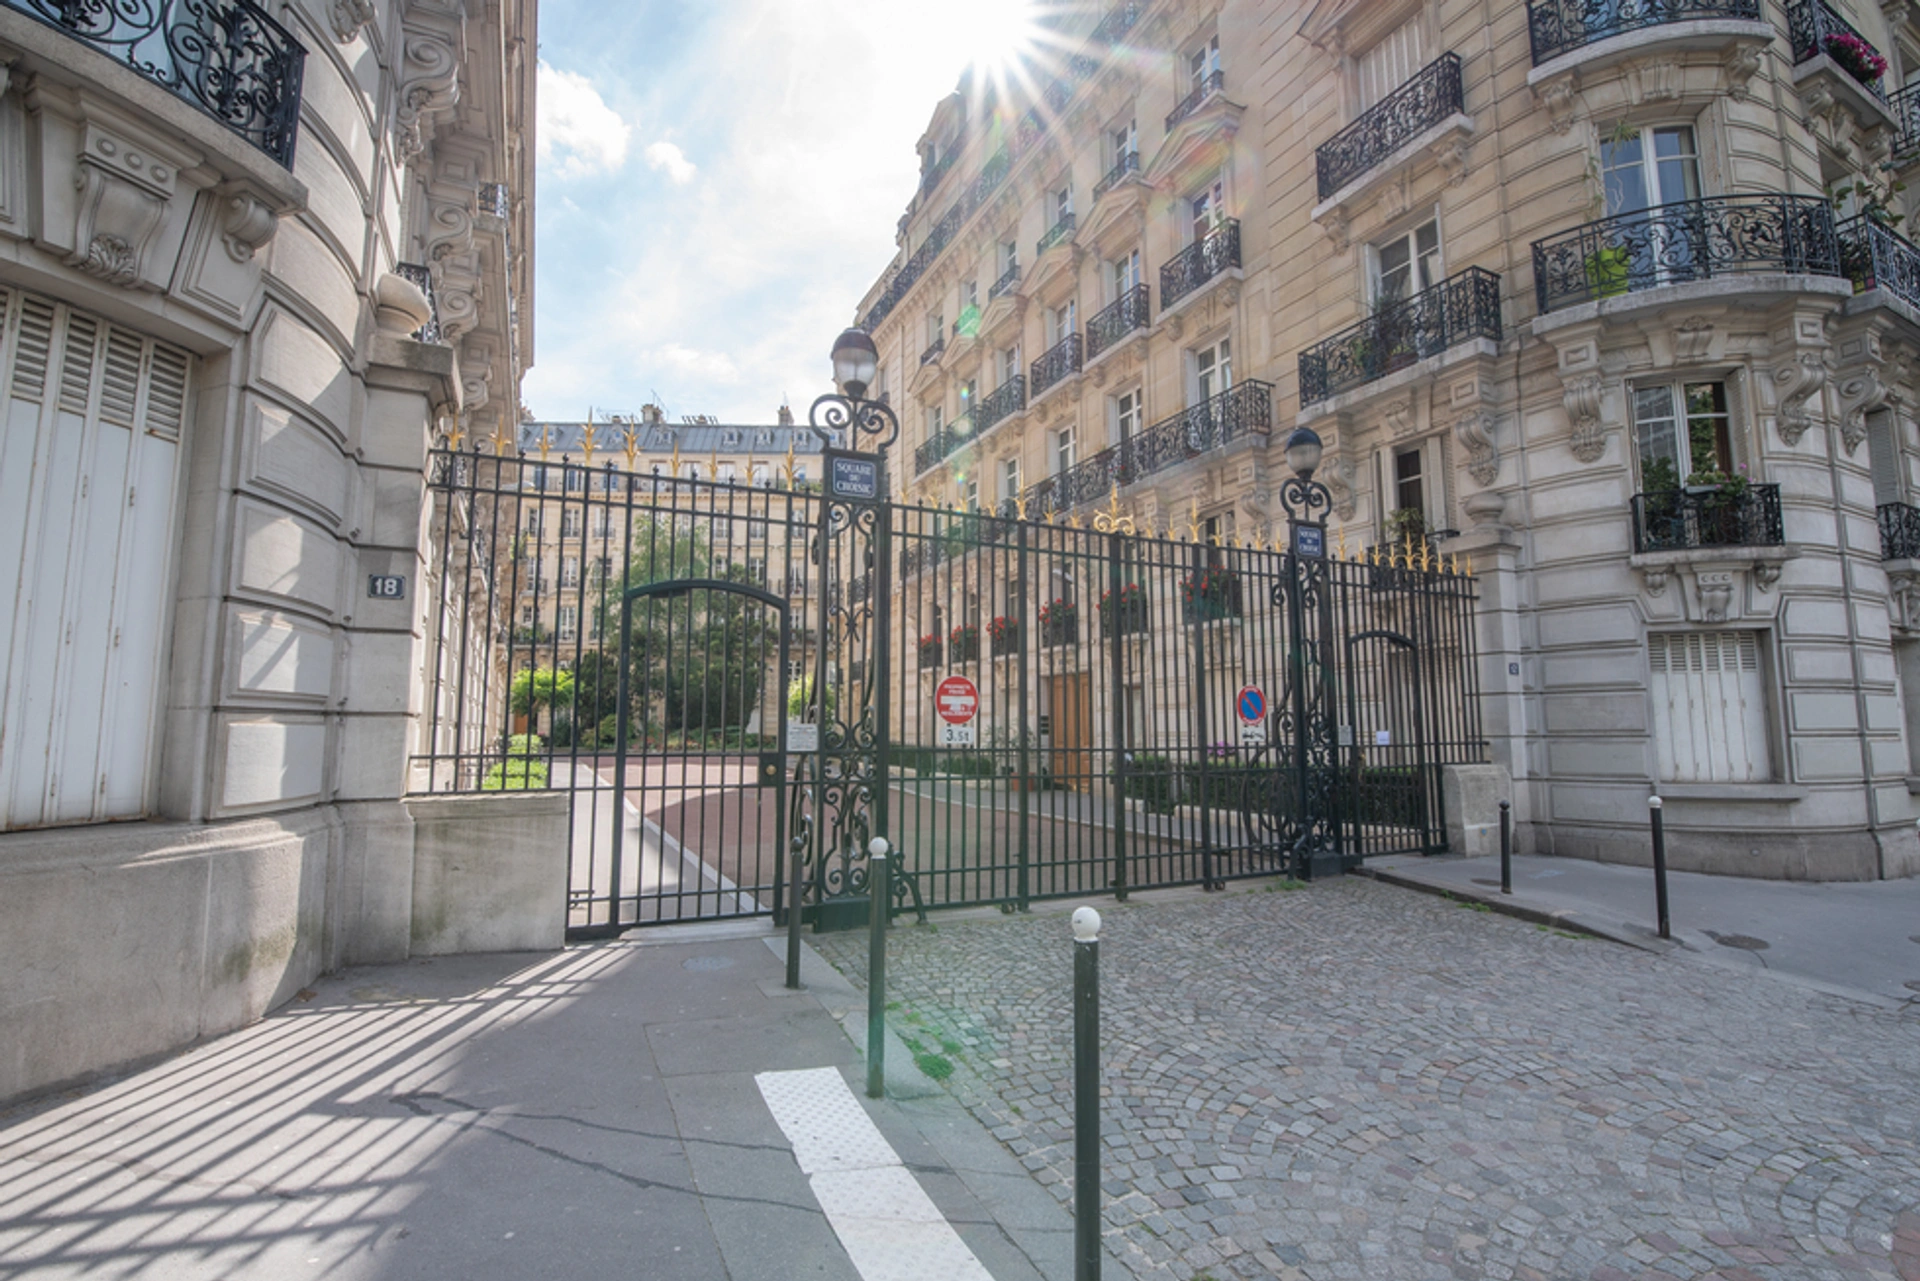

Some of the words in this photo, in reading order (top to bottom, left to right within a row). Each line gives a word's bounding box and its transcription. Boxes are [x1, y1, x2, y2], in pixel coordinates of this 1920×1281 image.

[836, 462, 871, 475] SQUARE
[836, 480, 872, 493] CROISIC
[375, 578, 397, 595] 18
